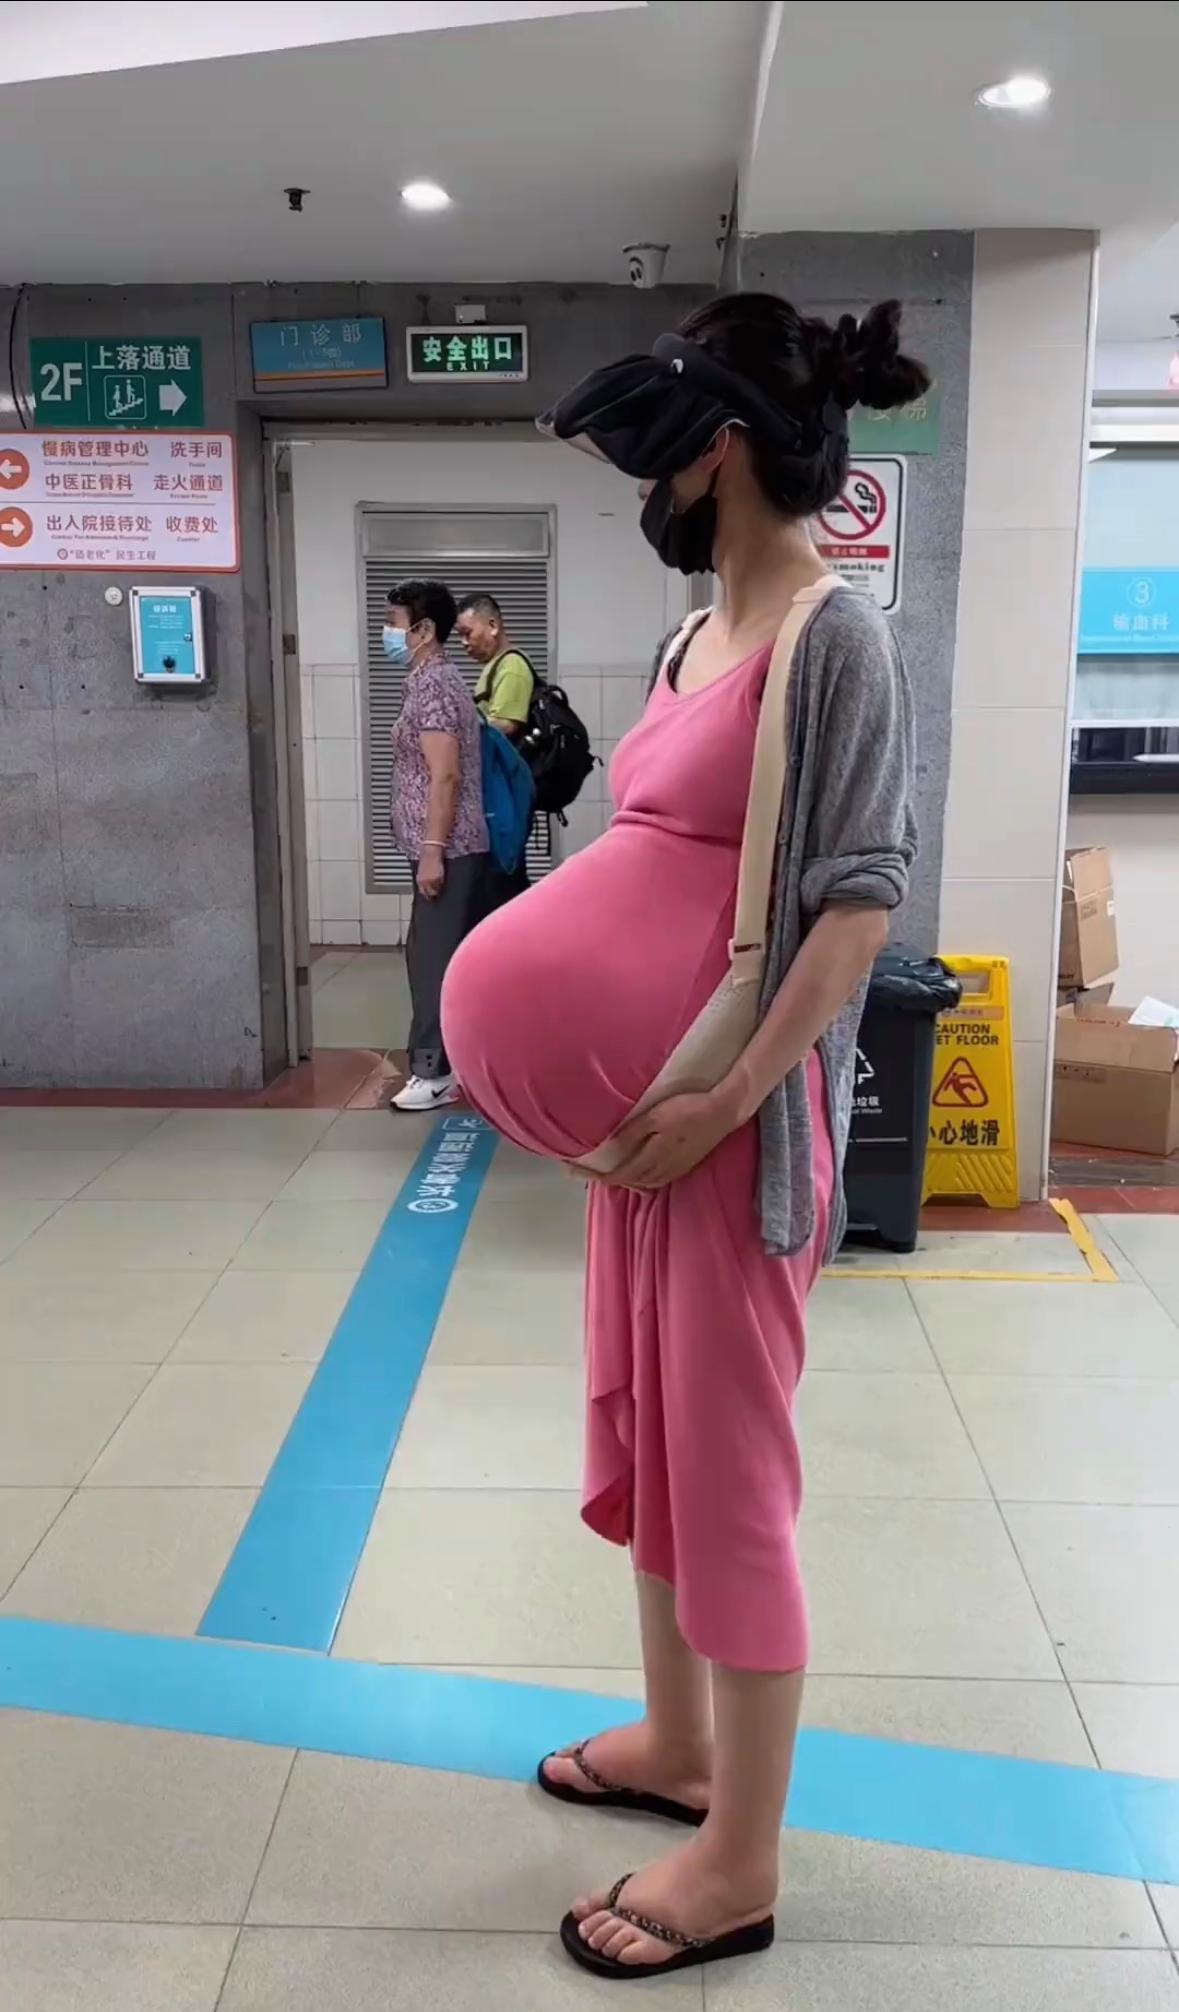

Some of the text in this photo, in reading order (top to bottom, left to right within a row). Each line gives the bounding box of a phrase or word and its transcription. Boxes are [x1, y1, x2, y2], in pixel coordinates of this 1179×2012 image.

[280, 323, 362, 347] 门诊部
[91, 345, 191, 371] 上落通道
[422, 335, 512, 362] 安全出口
[446, 361, 490, 372] EXIT
[40, 362, 83, 402] 2F
[41, 439, 222, 458] 慢病管理中心 洗手间
[45, 473, 223, 491] 中医正骨科 走火通道
[46, 514, 219, 534] 出入院接待处 收费处
[935, 1034, 1000, 1046] ET FLOOR
[853, 1095, 880, 1107] 垃圾
